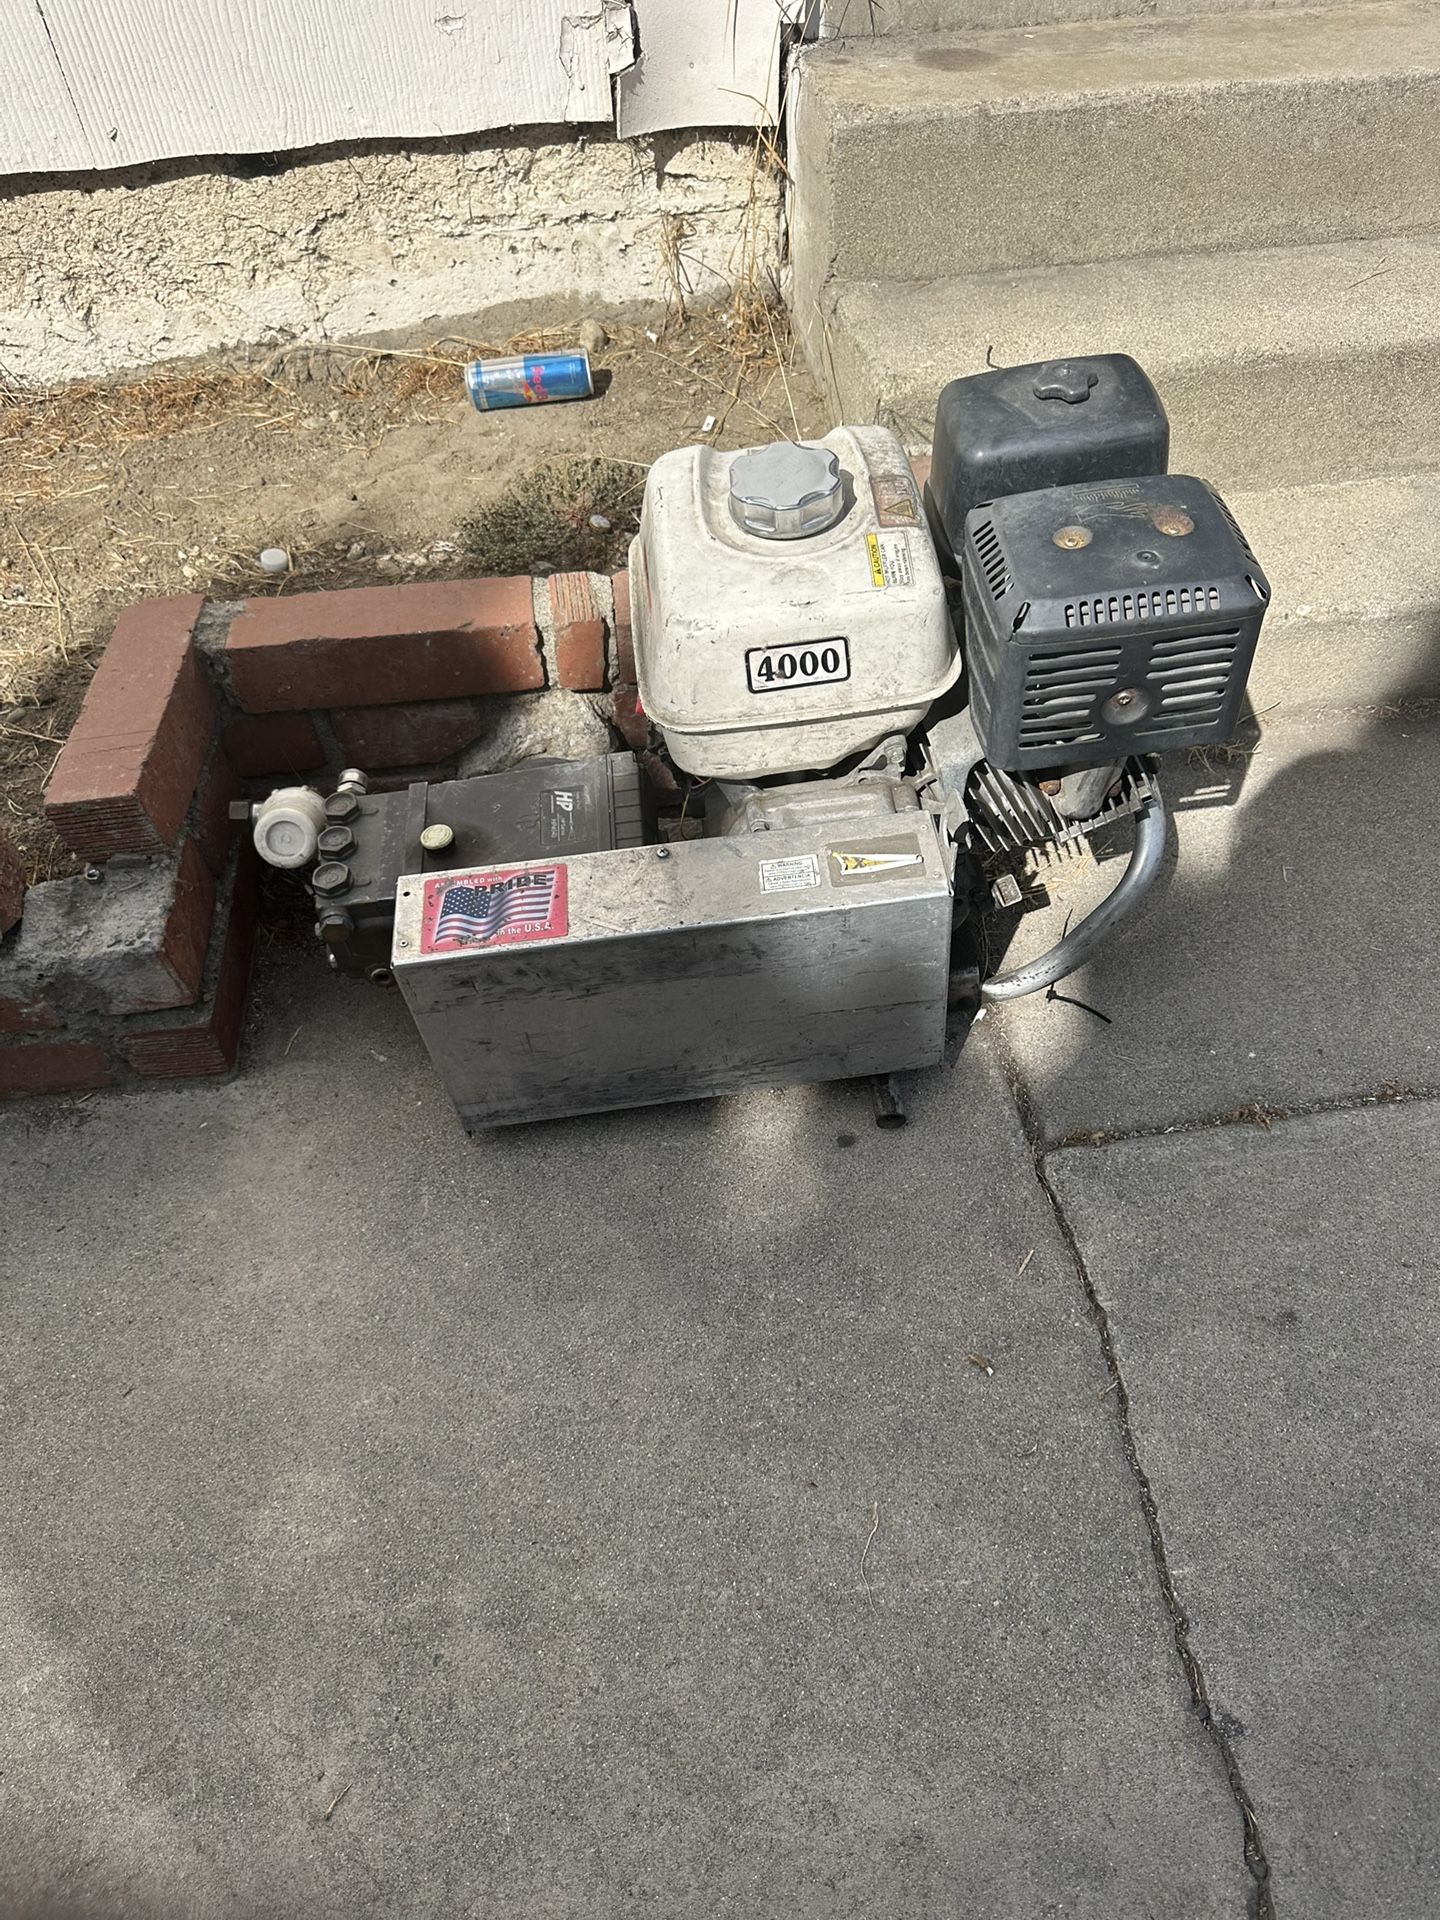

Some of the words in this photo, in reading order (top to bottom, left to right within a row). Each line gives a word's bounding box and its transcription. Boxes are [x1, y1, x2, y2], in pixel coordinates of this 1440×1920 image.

[871, 544, 881, 568] CAUTION
[758, 648, 840, 682] 4000
[553, 790, 573, 812] HP
[434, 878, 485, 888] AMBLED
[474, 874, 548, 896] PRIDE
[508, 927, 521, 935] the
[524, 921, 554, 933] U.S.A.
